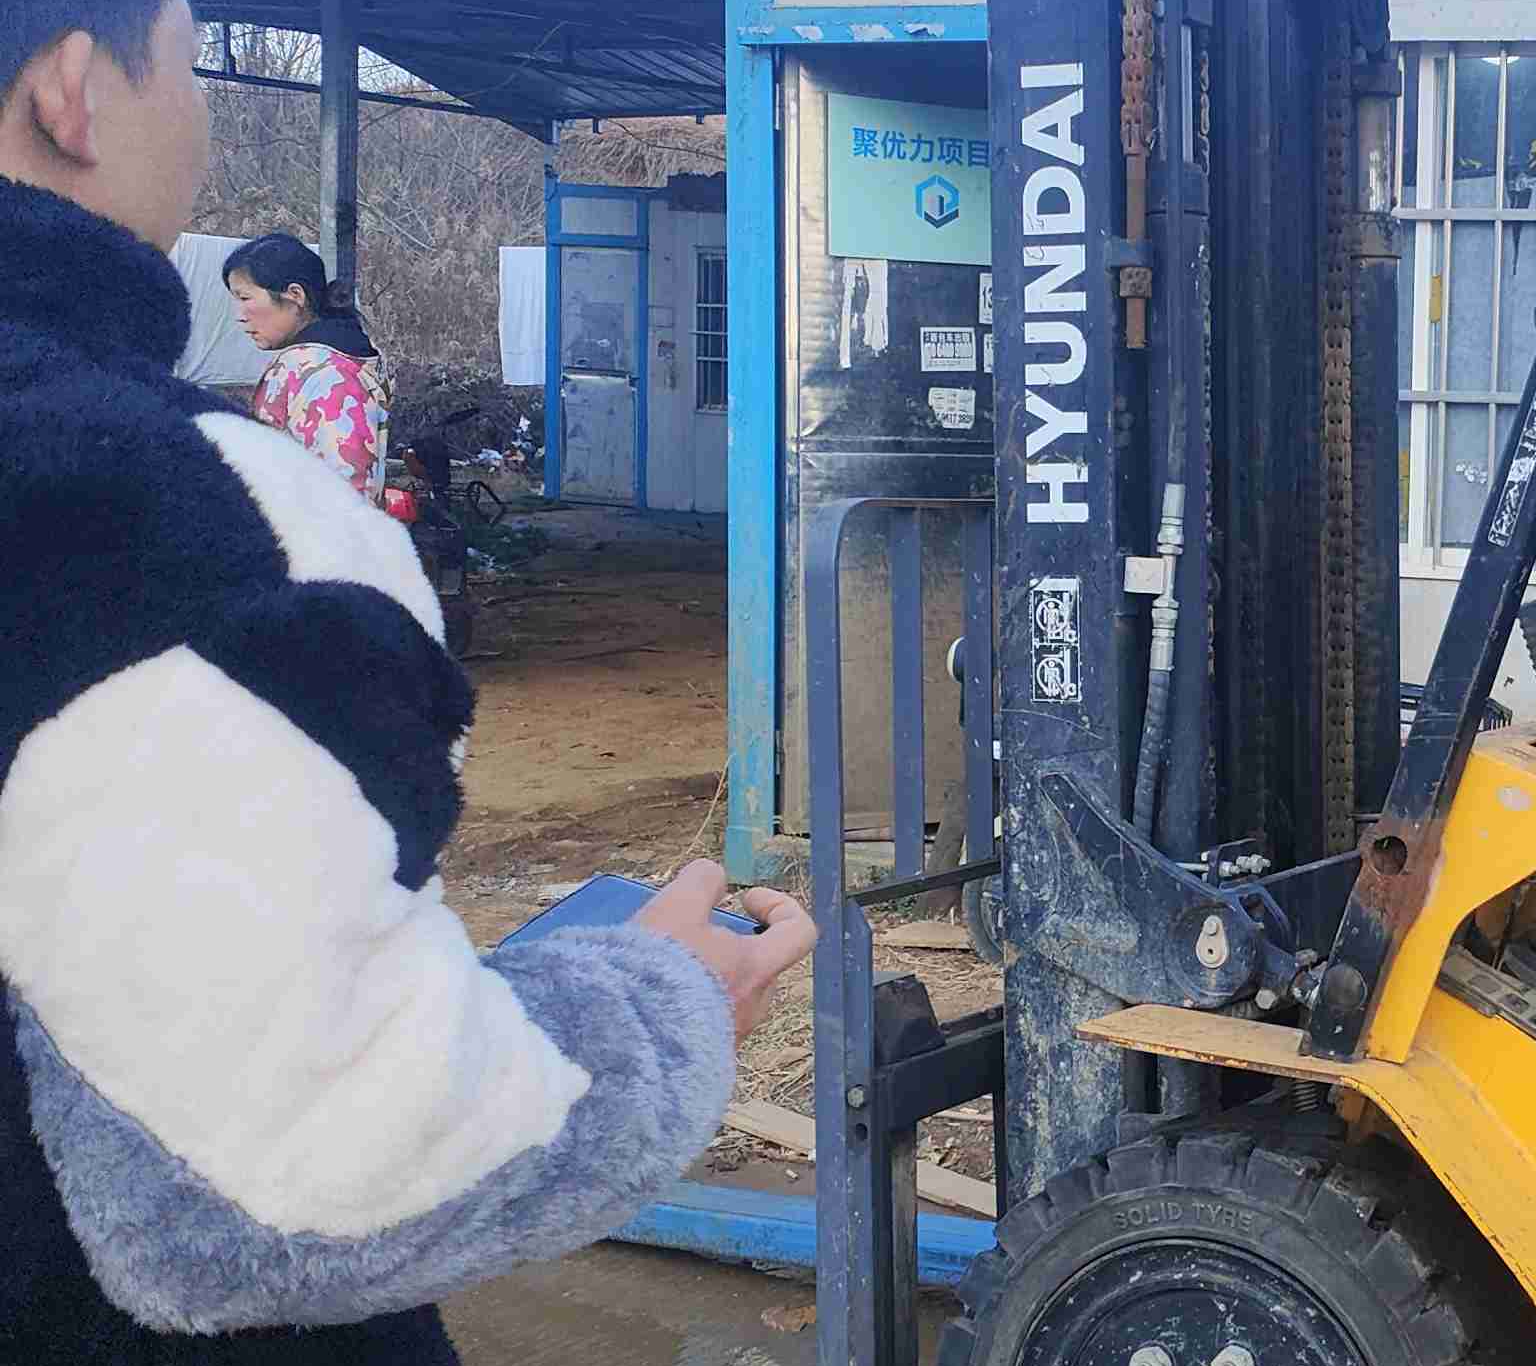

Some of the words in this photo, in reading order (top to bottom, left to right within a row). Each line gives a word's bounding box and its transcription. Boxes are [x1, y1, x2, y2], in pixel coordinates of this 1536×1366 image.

[852, 127, 991, 169] 聚优力项目
[1020, 61, 1089, 524] HYUNDAI
[1113, 1201, 1183, 1230] SOLID
[1191, 1201, 1255, 1232] TYRE
